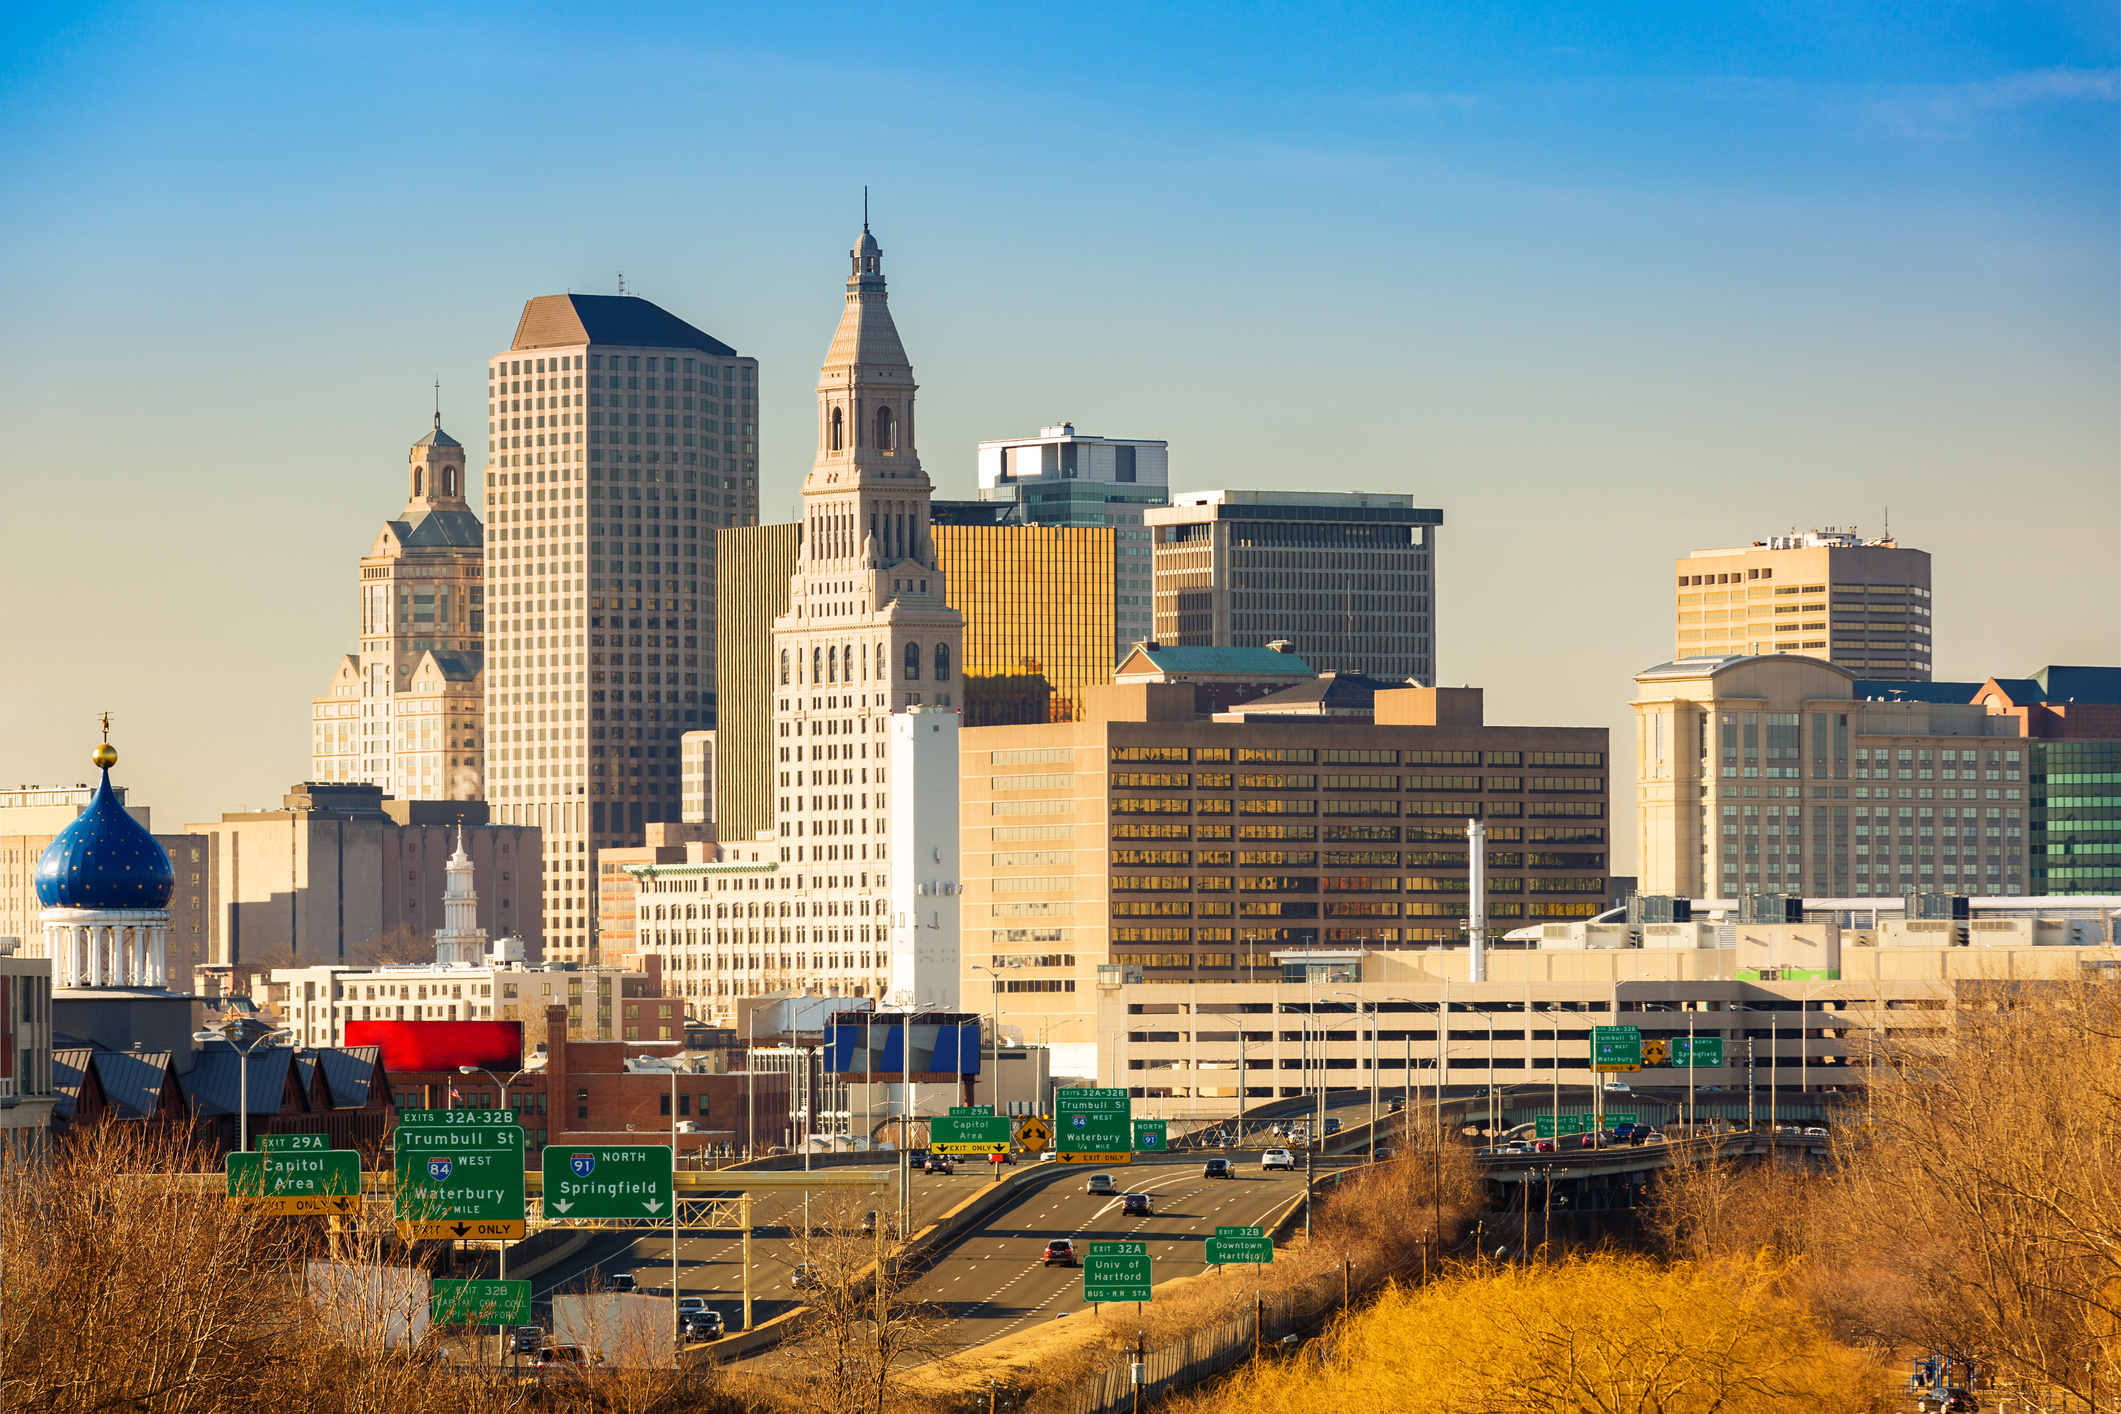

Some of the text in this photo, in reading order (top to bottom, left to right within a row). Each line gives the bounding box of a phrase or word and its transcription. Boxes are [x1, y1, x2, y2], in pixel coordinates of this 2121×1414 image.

[1678, 1051, 1717, 1059] Sprngfield
[1083, 1089, 1124, 1097] 32A-32B
[1061, 1101, 1125, 1109] Trumbull St
[404, 1112, 513, 1123] EXITS 32A-32B
[953, 1120, 989, 1129] Capitol
[262, 1136, 323, 1148] EXIT 29A
[404, 1132, 514, 1144] Trumbull St
[1067, 1133, 1120, 1143] Waterbury
[1145, 1136, 1155, 1144] 91
[458, 1156, 492, 1165] WEST
[602, 1152, 646, 1161] NORTH
[264, 1159, 323, 1174] Capitol
[430, 1164, 449, 1175] 84
[574, 1161, 589, 1172] 91
[274, 1177, 314, 1189] Area
[560, 1181, 656, 1198] Springfield
[415, 1187, 505, 1204] Waterbury
[454, 1206, 480, 1214] MILE
[478, 1225, 511, 1234] ONLY
[1240, 1228, 1259, 1236] 32B
[1118, 1244, 1141, 1253] 32A
[485, 1286, 508, 1296] 32B
